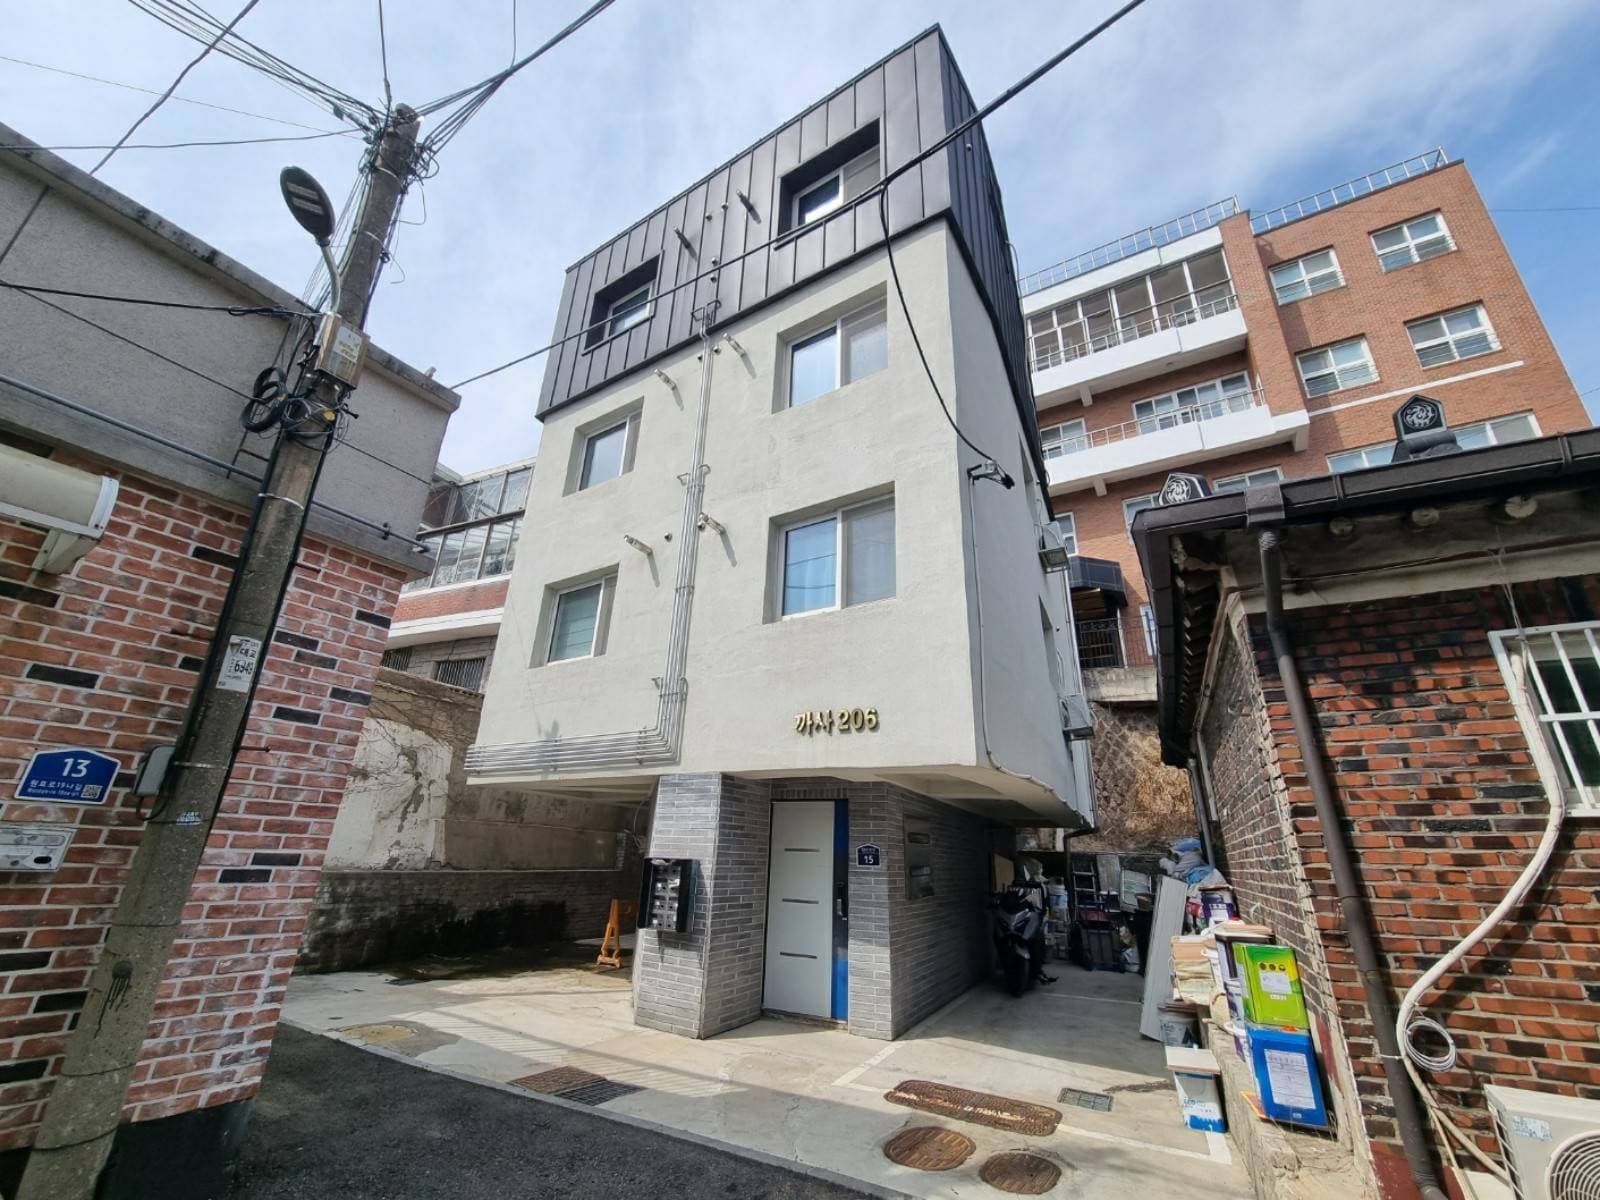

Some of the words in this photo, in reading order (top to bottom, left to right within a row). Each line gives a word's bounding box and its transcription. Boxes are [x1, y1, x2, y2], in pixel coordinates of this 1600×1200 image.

[794, 709, 834, 737] 까사
[838, 707, 880, 733] 206
[62, 758, 91, 777] 13
[864, 855, 874, 864] 15
